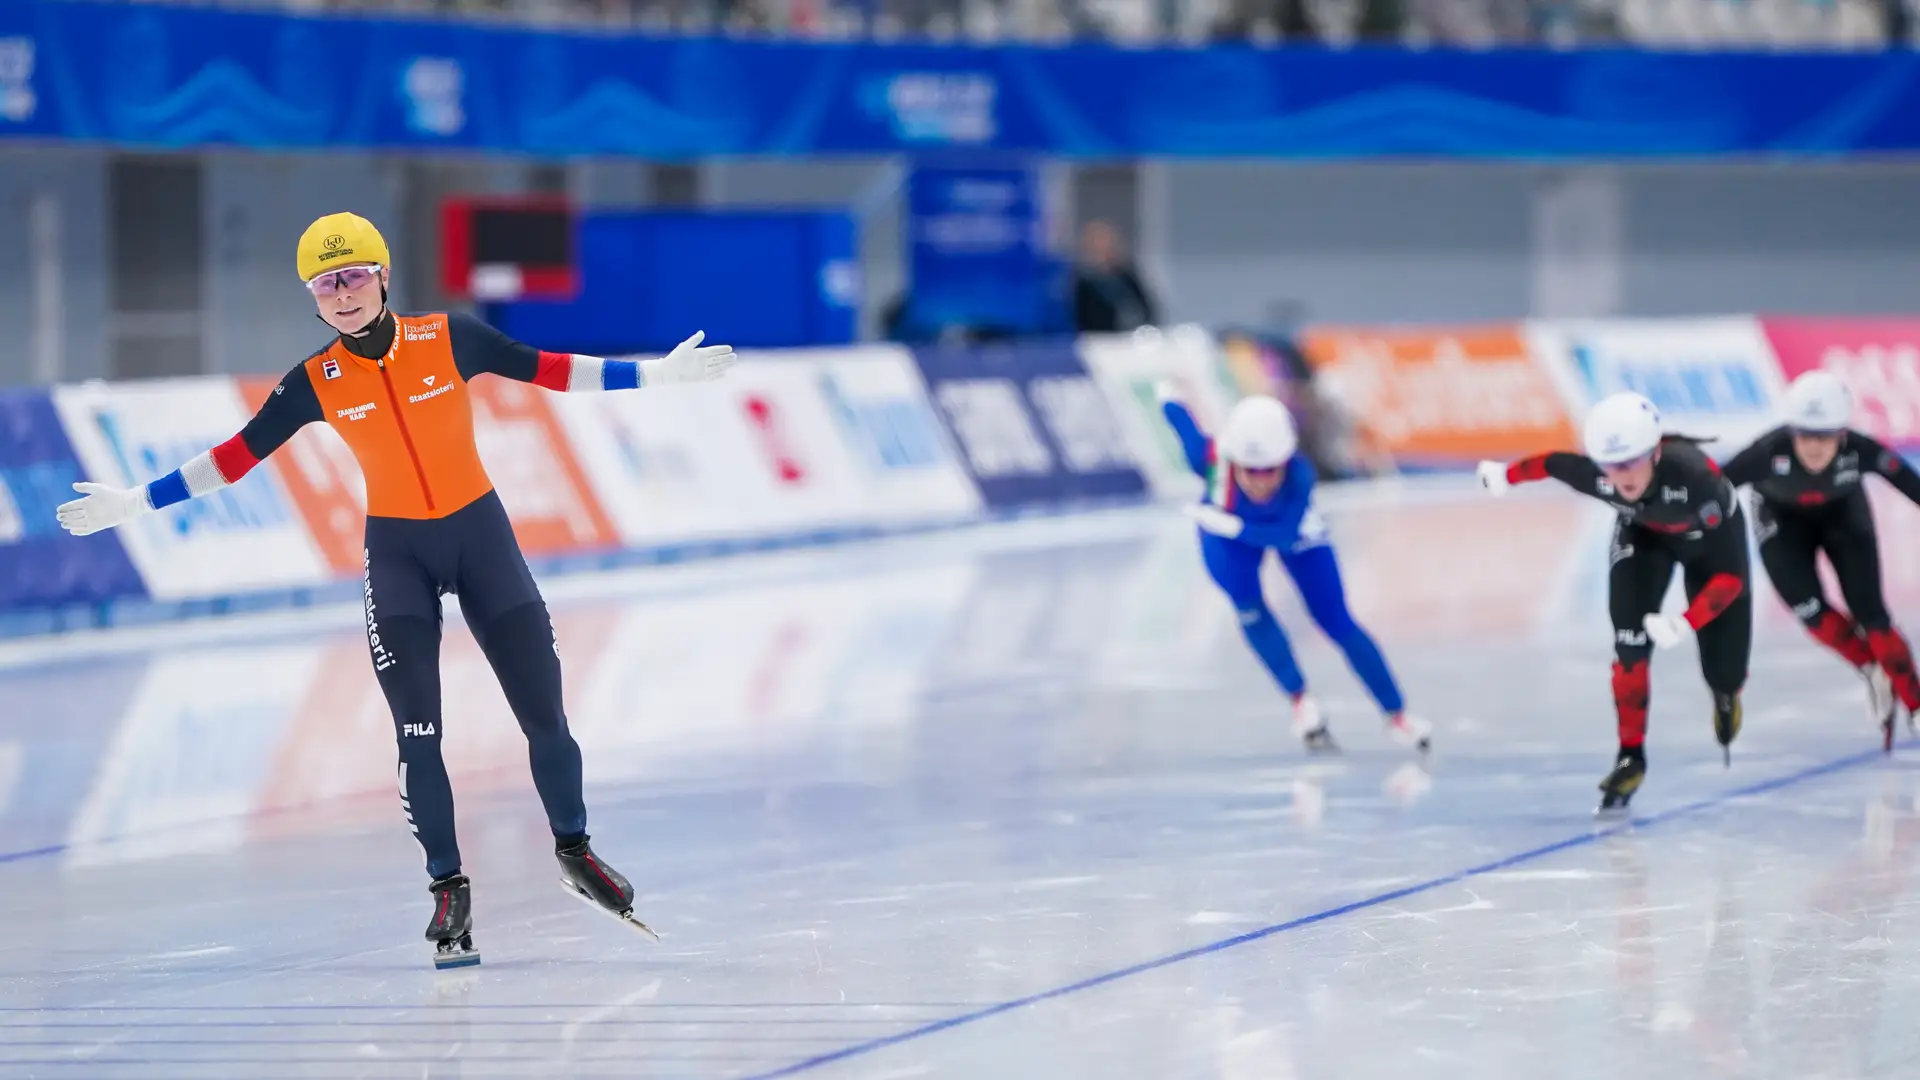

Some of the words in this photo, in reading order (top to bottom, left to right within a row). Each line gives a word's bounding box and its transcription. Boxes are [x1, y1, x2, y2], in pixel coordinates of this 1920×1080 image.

[327, 237, 341, 249] ISU
[407, 331, 418, 341] de
[418, 331, 437, 341] vries
[409, 380, 455, 403] Staatsloterij
[336, 402, 377, 418] ZAANLANDER
[349, 411, 367, 421] KAAS
[403, 721, 435, 737] FILA
